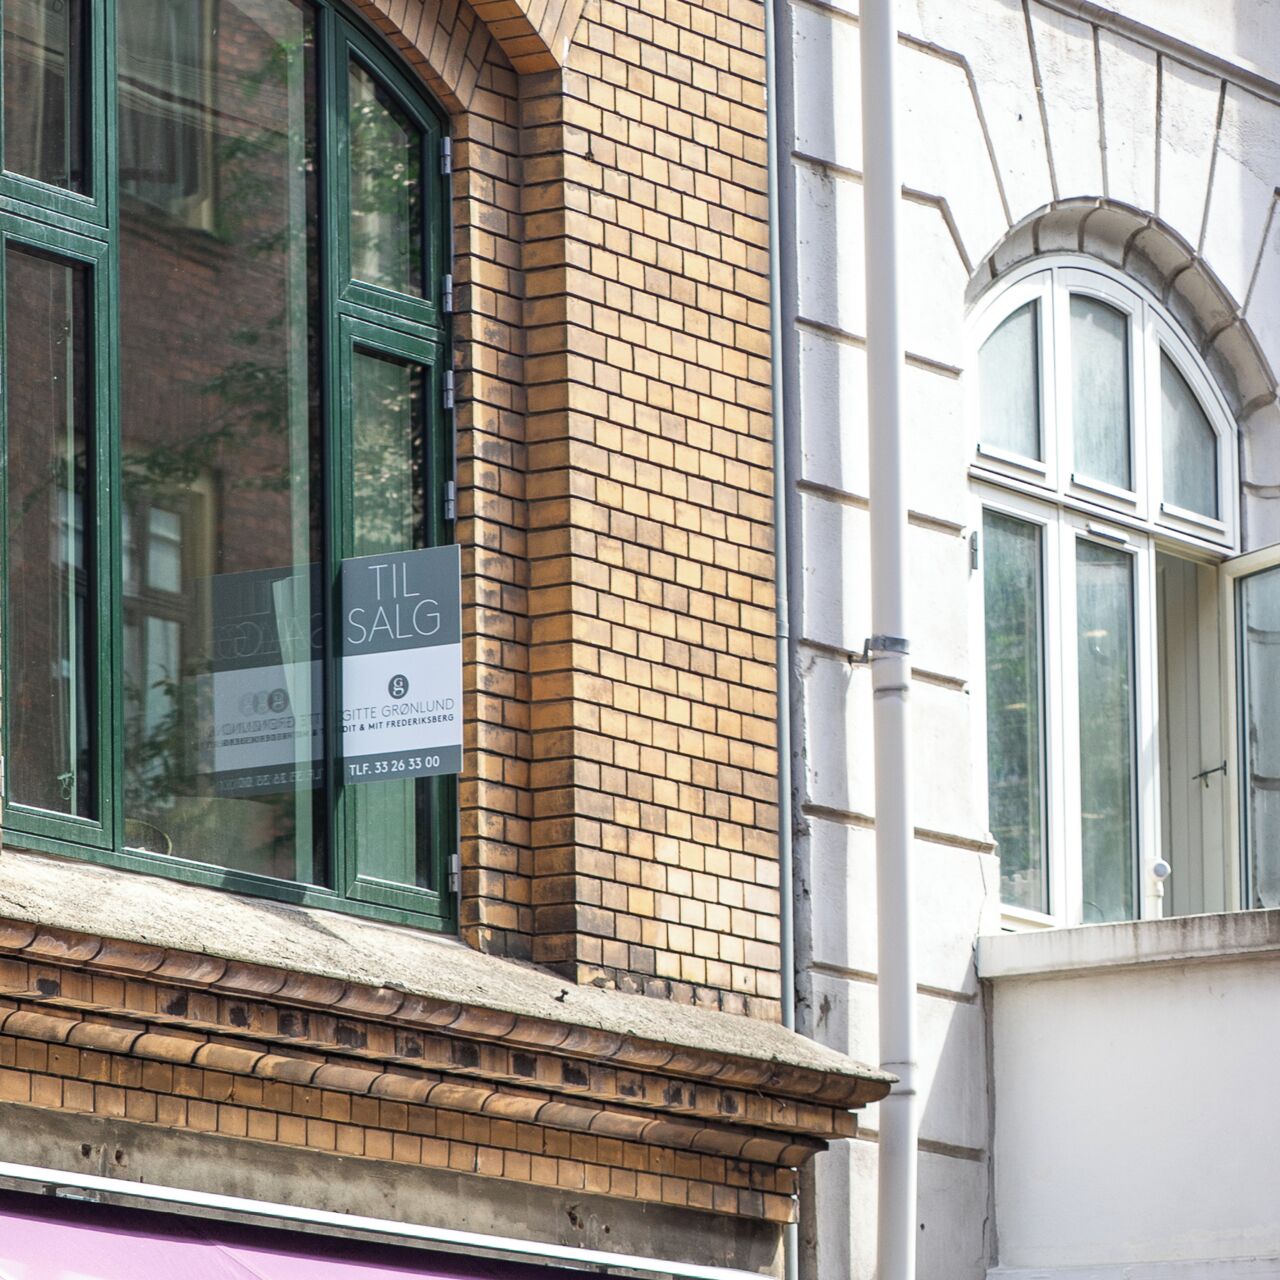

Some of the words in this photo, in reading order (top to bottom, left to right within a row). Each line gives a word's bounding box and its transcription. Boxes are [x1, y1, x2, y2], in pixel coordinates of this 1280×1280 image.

[367, 563, 420, 600] TIL
[346, 599, 442, 645] SALG
[342, 706, 377, 722] GITTE
[381, 698, 455, 719] GRØNLUND
[342, 724, 356, 733] DIT
[359, 723, 366, 731] &
[368, 721, 383, 730] MIT
[386, 713, 455, 728] FREDERIKSBERG
[348, 763, 372, 776] TLF.
[374, 761, 388, 773] 33
[391, 759, 405, 772] 26
[408, 757, 422, 769] 33
[425, 755, 440, 768] 00
